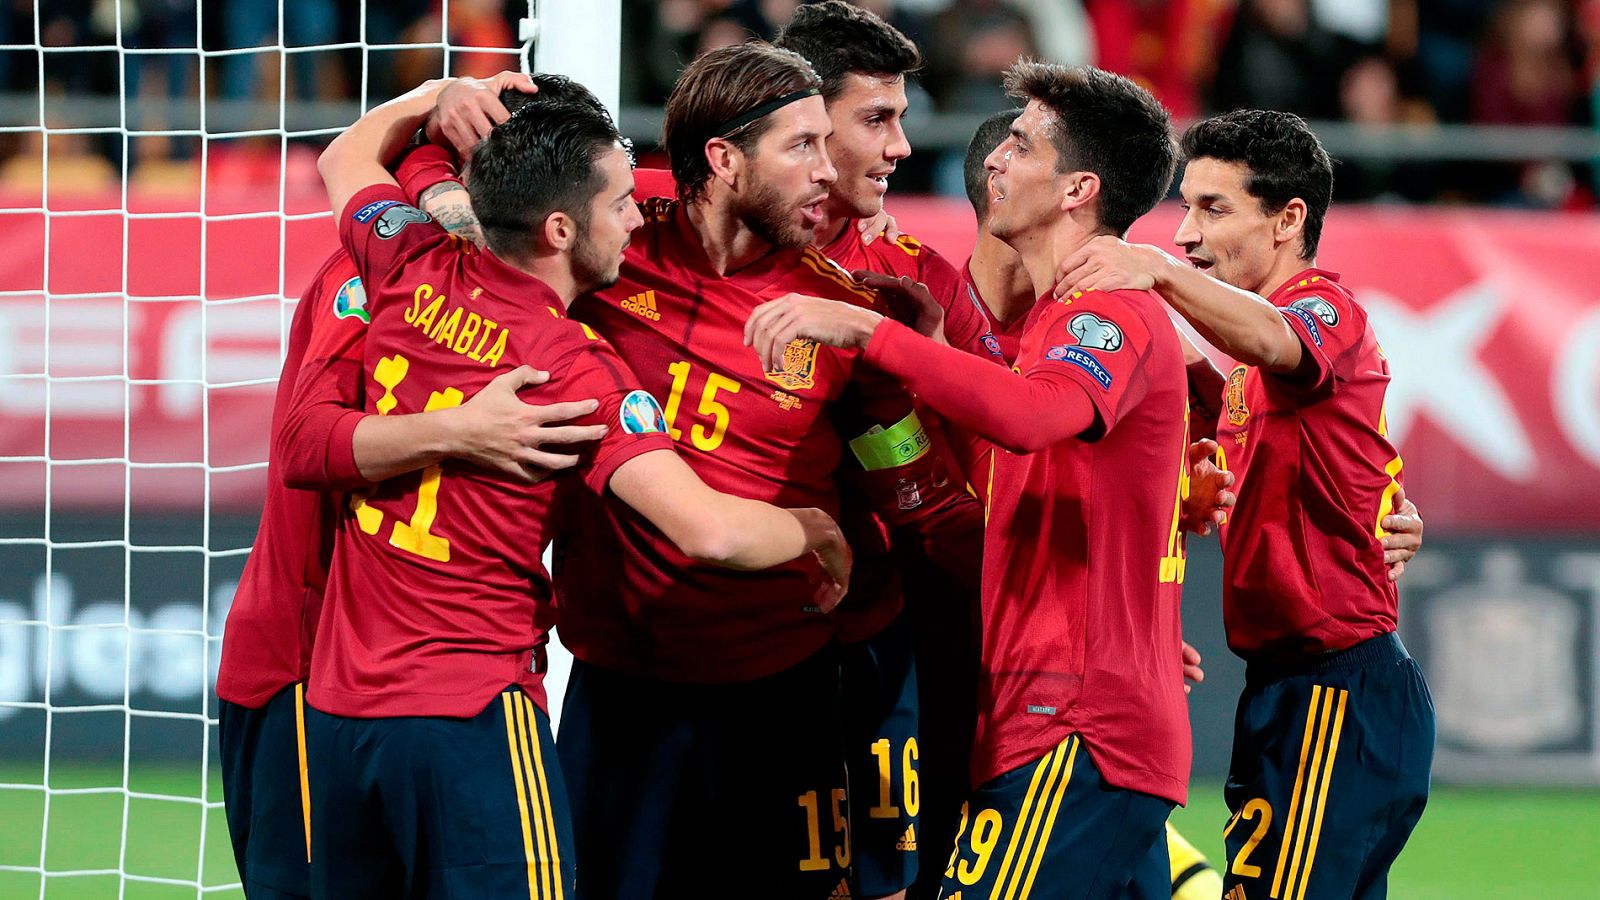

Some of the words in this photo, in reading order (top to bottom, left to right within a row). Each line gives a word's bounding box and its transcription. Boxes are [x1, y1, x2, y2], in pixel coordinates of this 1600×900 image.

[620, 299, 661, 321] adidas
[666, 360, 741, 452] 15
[1067, 350, 1112, 385] RESPECT
[869, 736, 920, 819] 16
[798, 788, 850, 872] 15
[1223, 798, 1273, 878] 2
